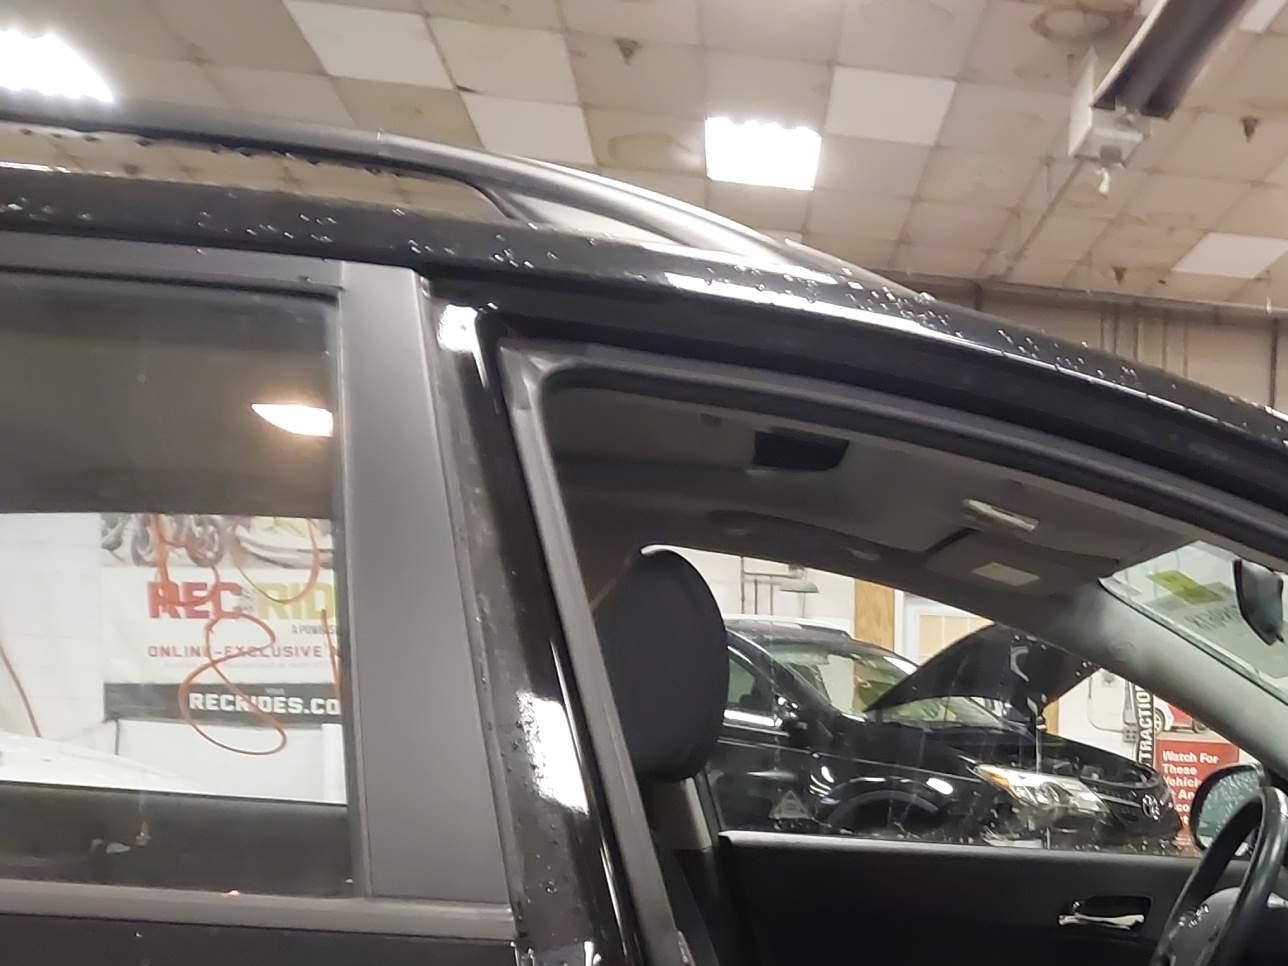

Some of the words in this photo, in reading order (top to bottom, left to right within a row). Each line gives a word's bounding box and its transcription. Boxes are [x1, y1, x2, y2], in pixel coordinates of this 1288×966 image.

[147, 581, 243, 619] REC
[1135, 686, 1153, 767] TRACTIO
[1162, 750, 1198, 763] Watch
[1199, 752, 1220, 764] For
[1162, 763, 1198, 775] These
[1163, 775, 1203, 788] Vehicl
